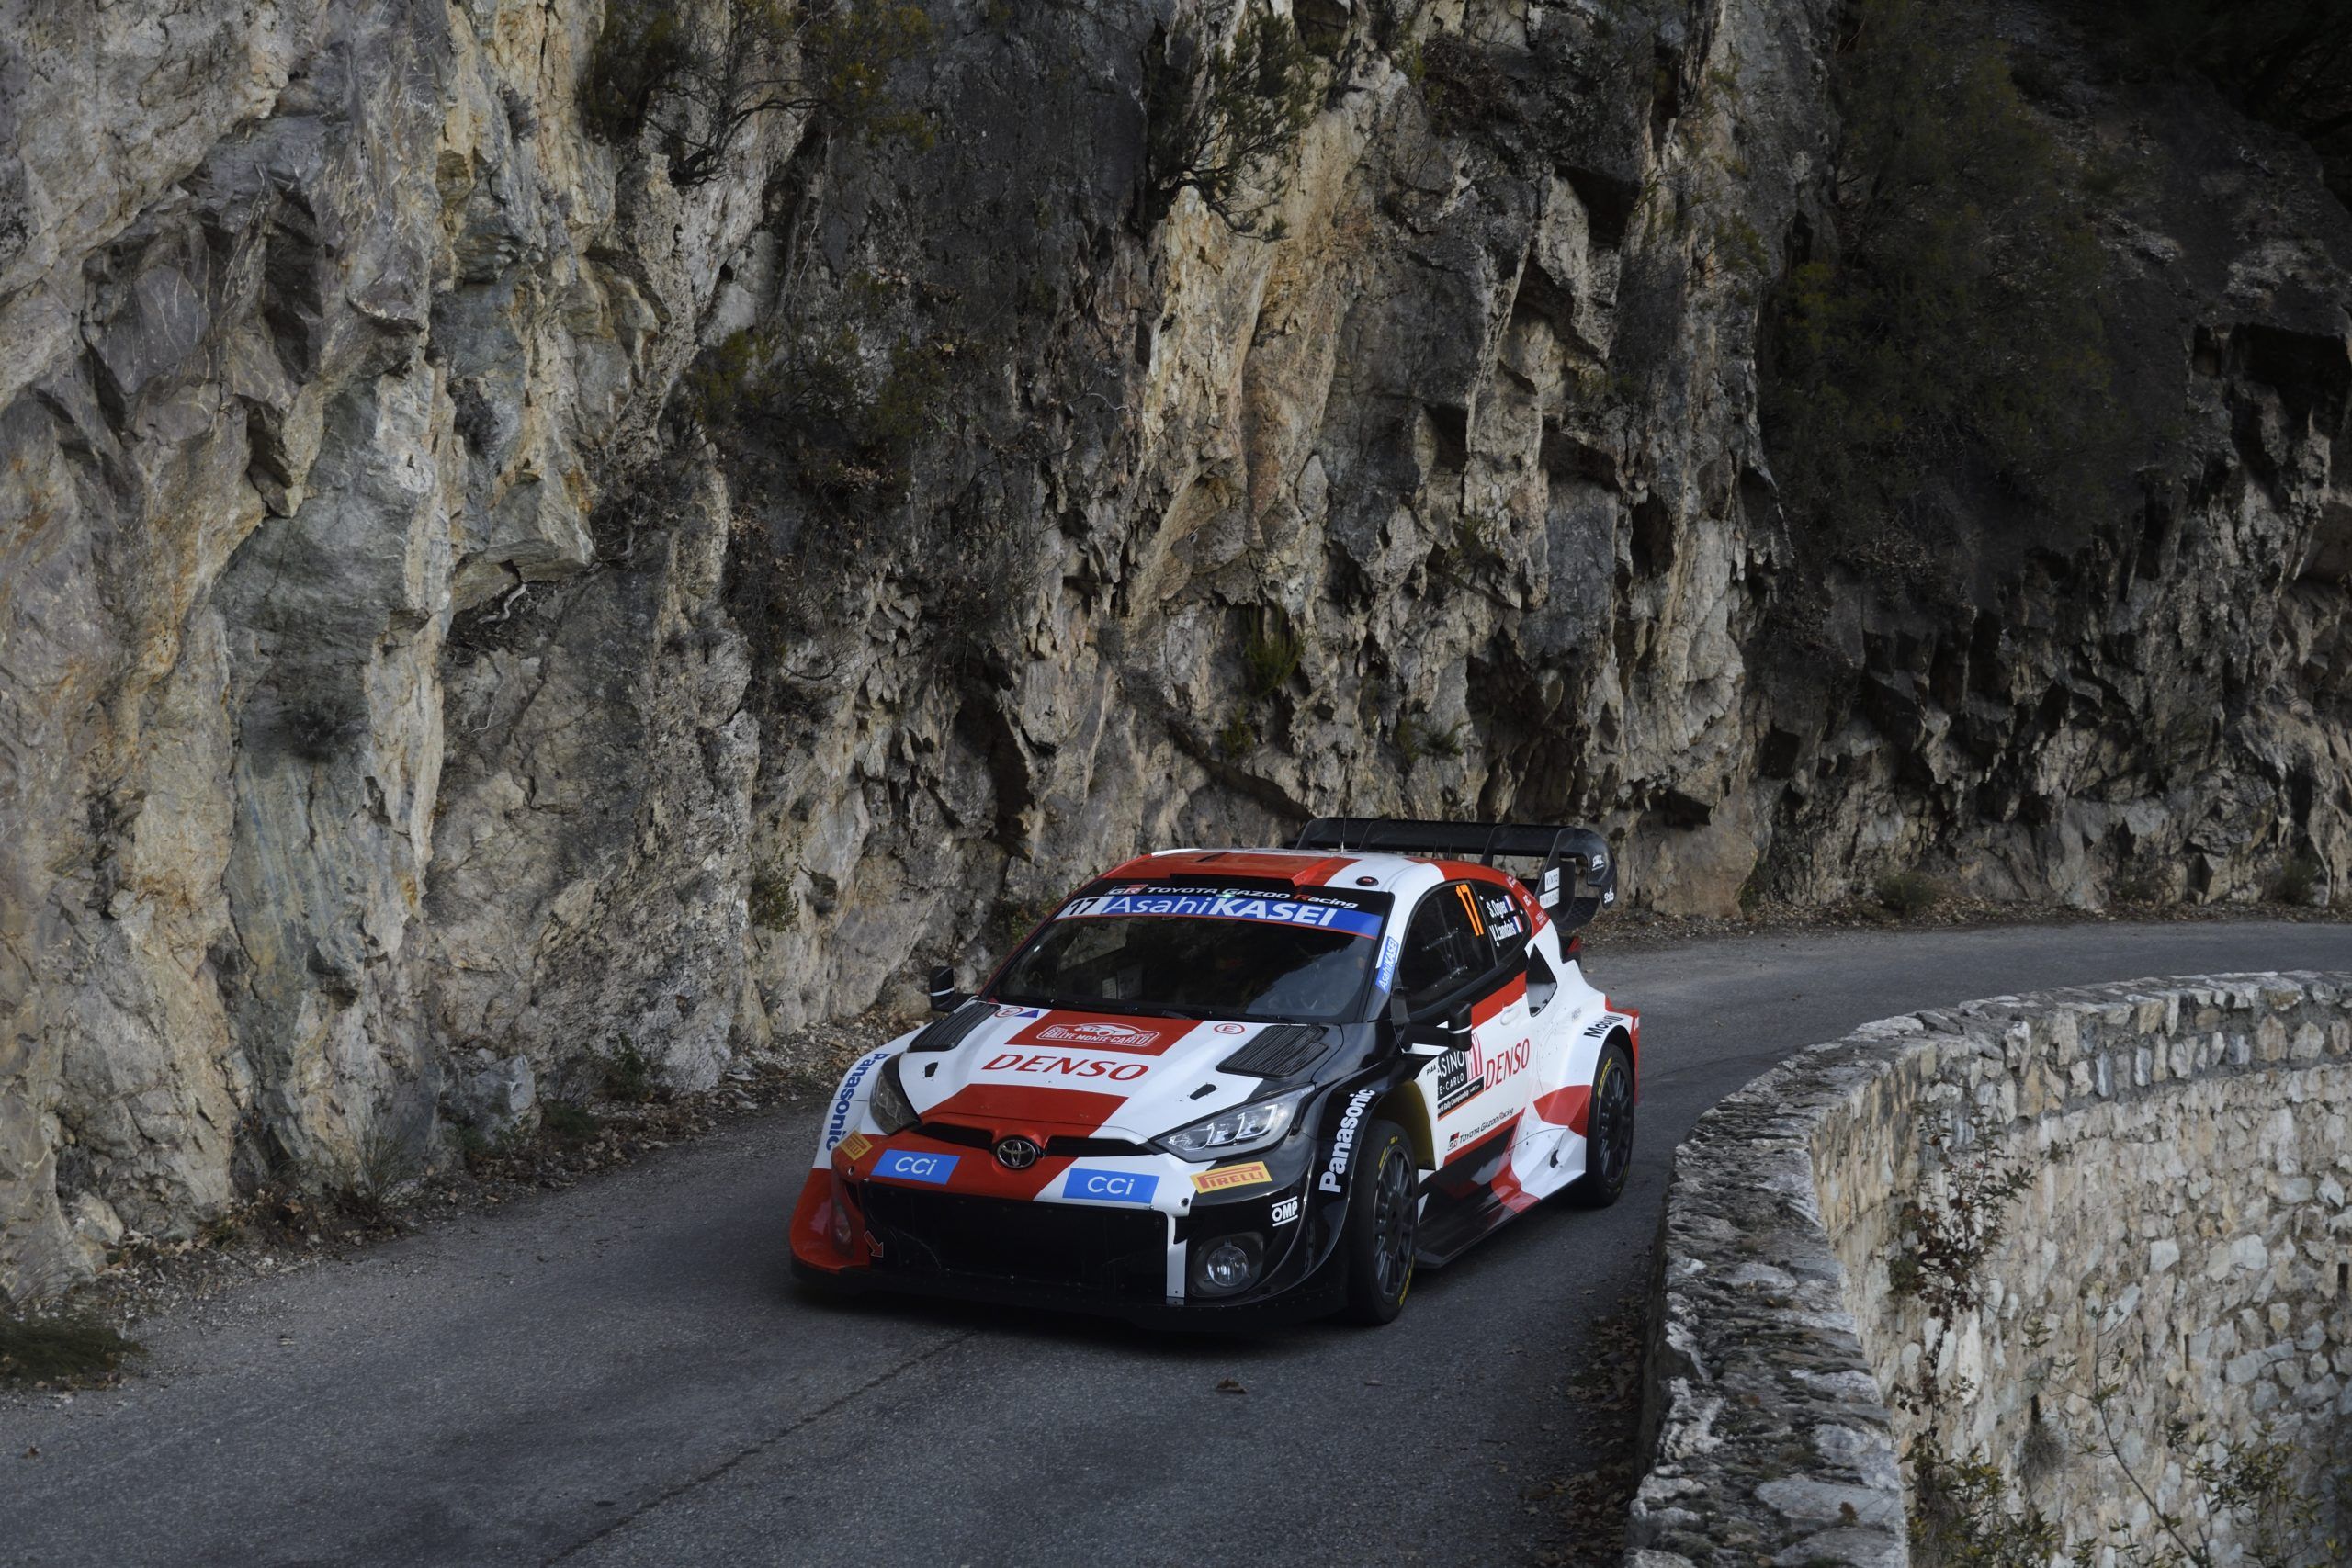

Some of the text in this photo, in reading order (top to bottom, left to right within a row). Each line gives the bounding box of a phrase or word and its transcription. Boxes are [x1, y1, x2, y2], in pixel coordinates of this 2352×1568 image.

[1069, 898, 1099, 916] 17
[1105, 885, 1359, 908] GR TOYOTA GAZOO Racing
[1456, 884, 1485, 937] 17
[1042, 1027, 1076, 1039] RALLYE
[980, 1054, 1150, 1081] DENSO
[1485, 1037, 1530, 1090] DENSO
[825, 1053, 892, 1151] Panasonic
[1318, 1089, 1376, 1194] Panasonic
[1460, 1126, 1481, 1144] TOYOTA
[1198, 1164, 1264, 1190] PIRELLI
[1272, 1200, 1299, 1219] OMP
